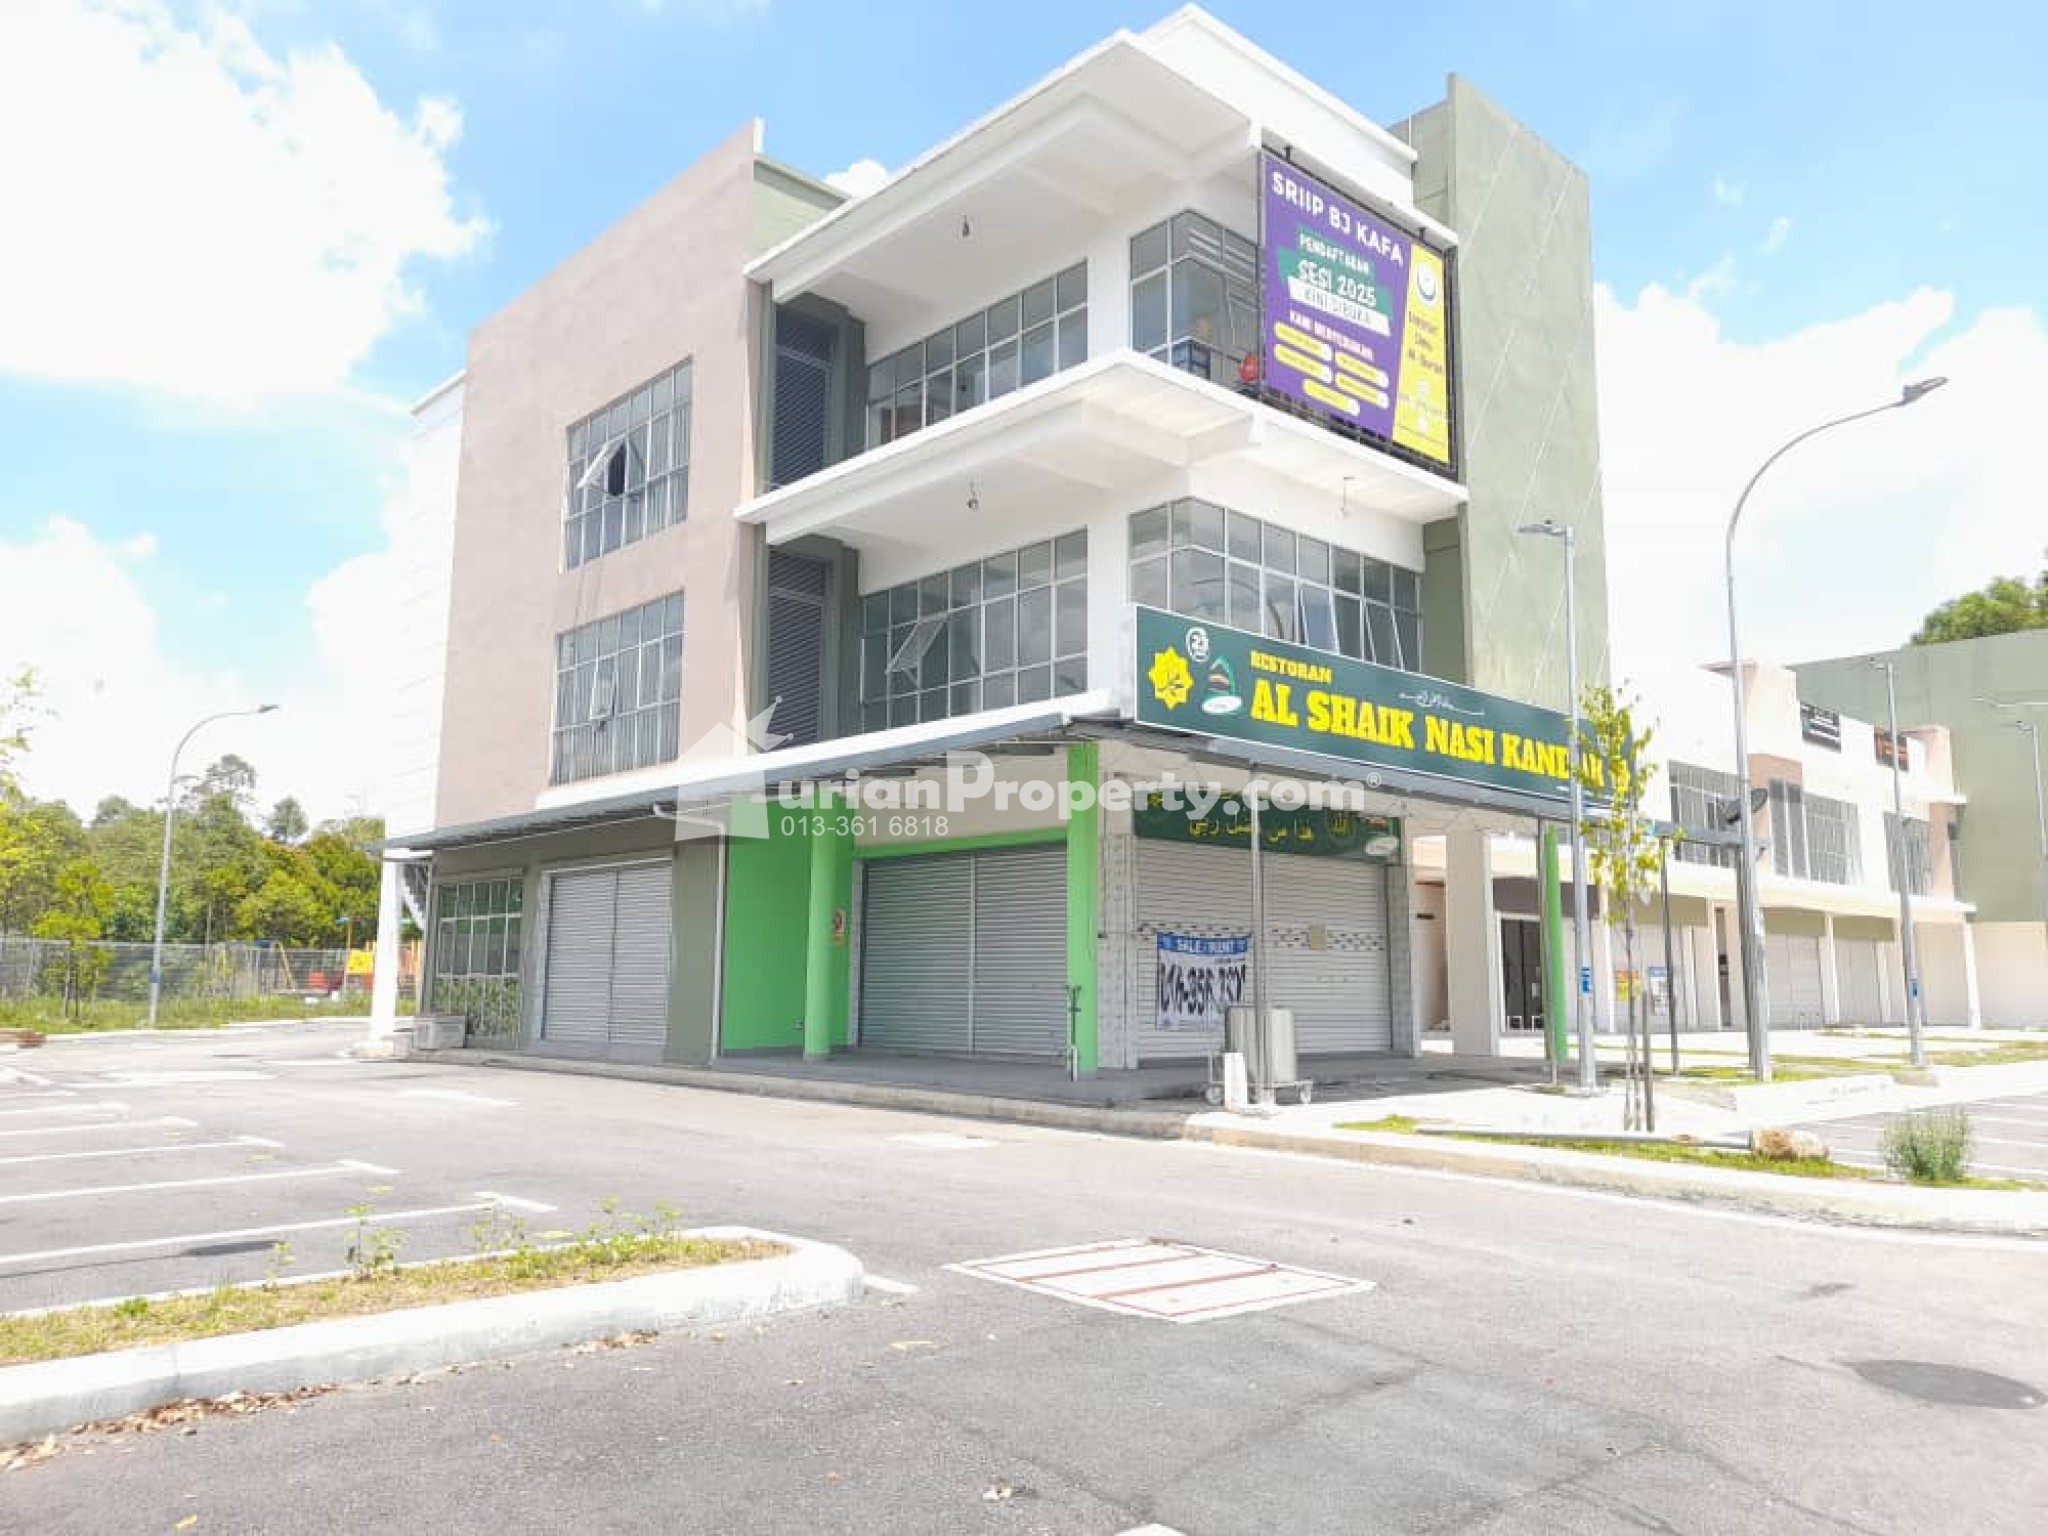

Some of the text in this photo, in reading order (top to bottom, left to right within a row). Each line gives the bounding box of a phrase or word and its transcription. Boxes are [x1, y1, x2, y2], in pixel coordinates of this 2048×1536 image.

[1272, 171, 1404, 268] SRIIP BJ KAFA
[1298, 260, 1377, 308] SESI 2025
[1249, 650, 1333, 684] RESTORAN
[1250, 678, 1299, 727] AL
[1306, 689, 1415, 751] SHAIK
[1424, 714, 1496, 765] NASI
